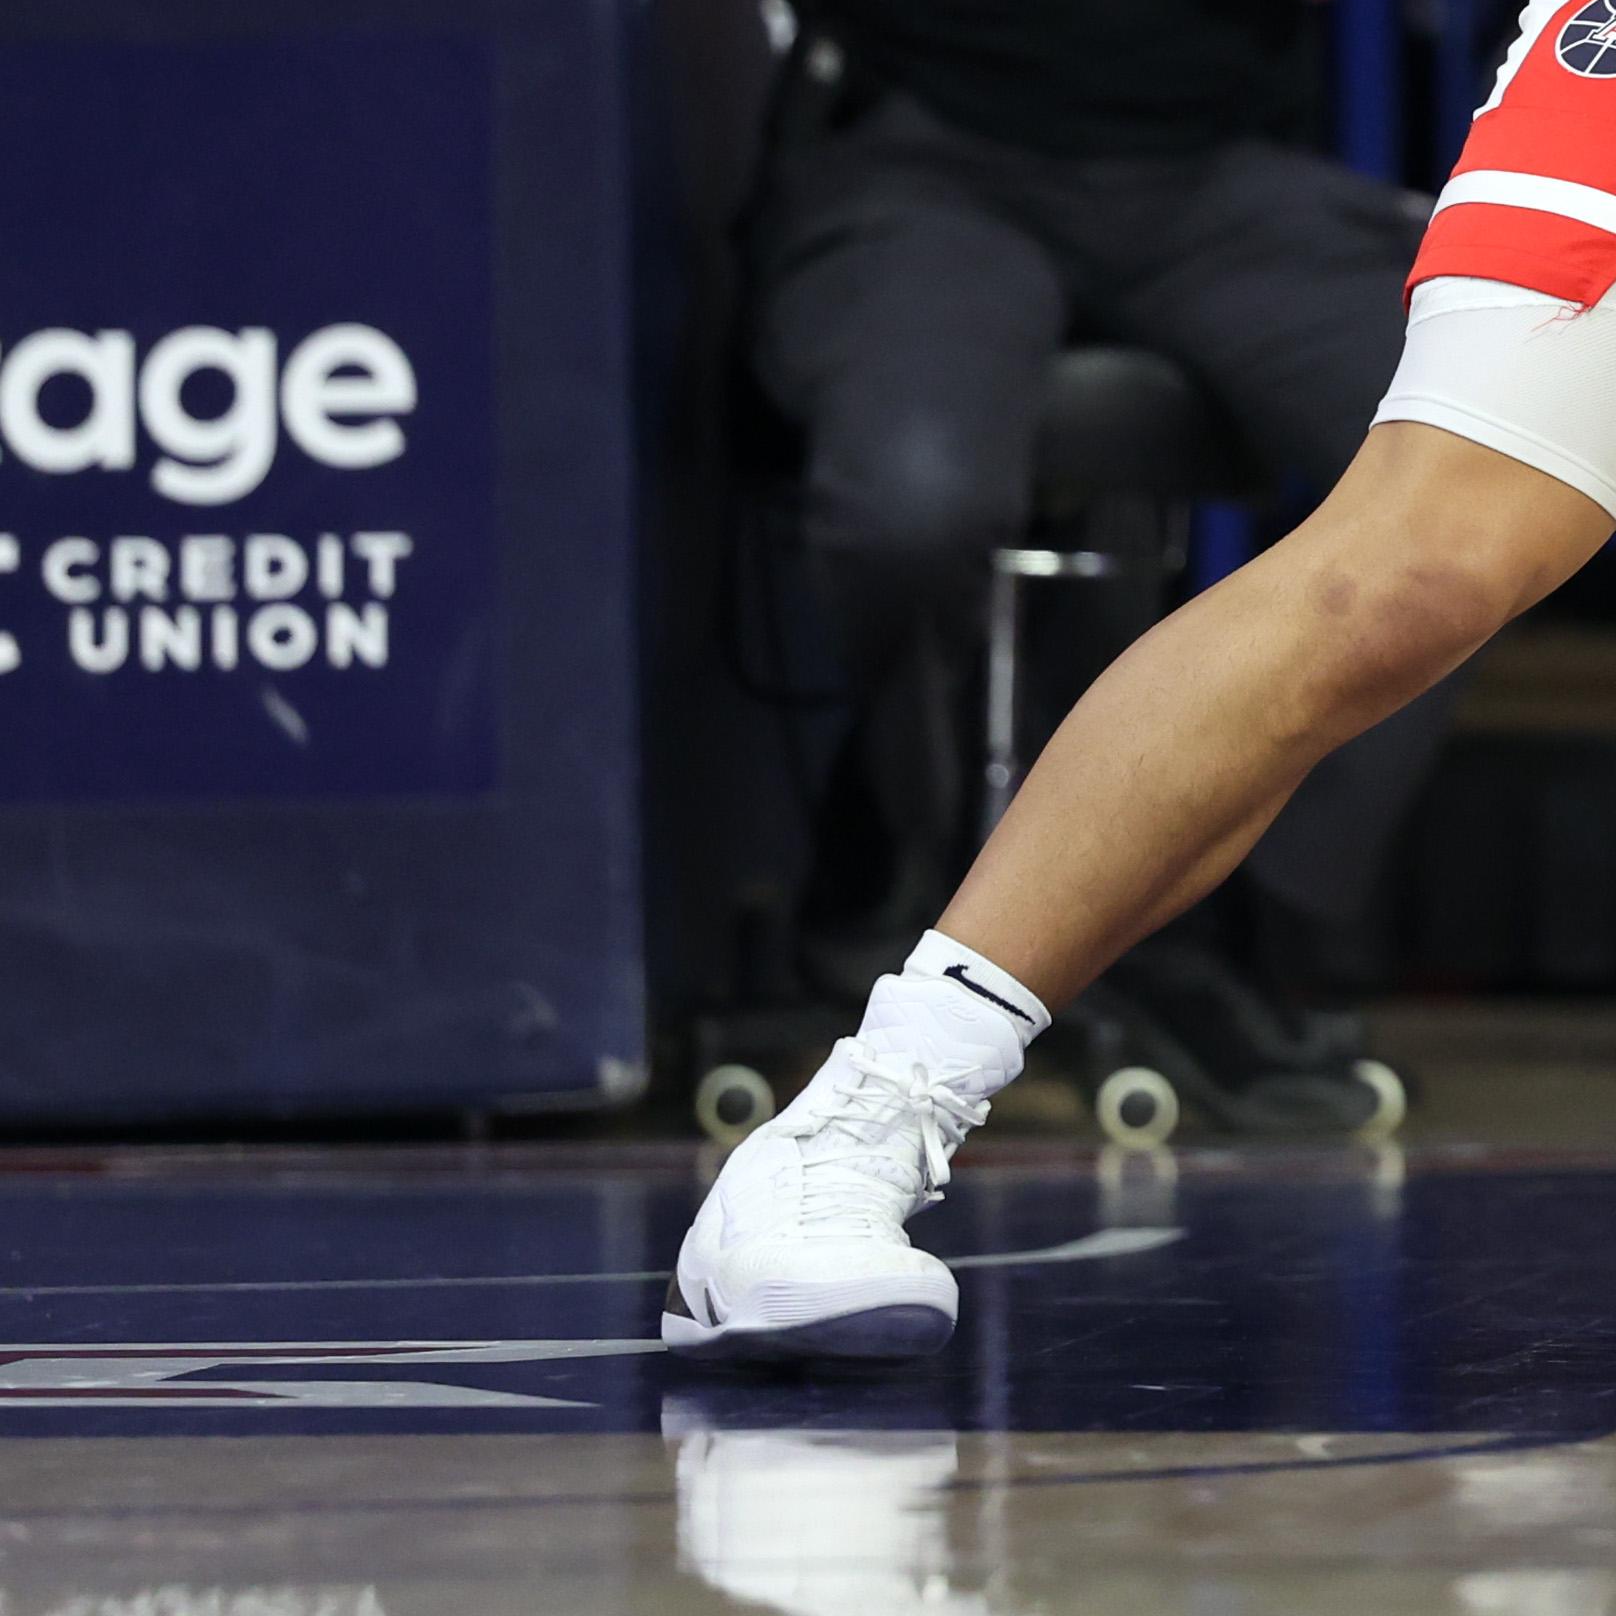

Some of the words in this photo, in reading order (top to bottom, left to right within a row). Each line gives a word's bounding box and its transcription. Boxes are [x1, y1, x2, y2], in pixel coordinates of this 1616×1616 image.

[0, 322, 417, 506] age
[42, 531, 414, 604] CREDIT
[69, 601, 389, 674] UNION
